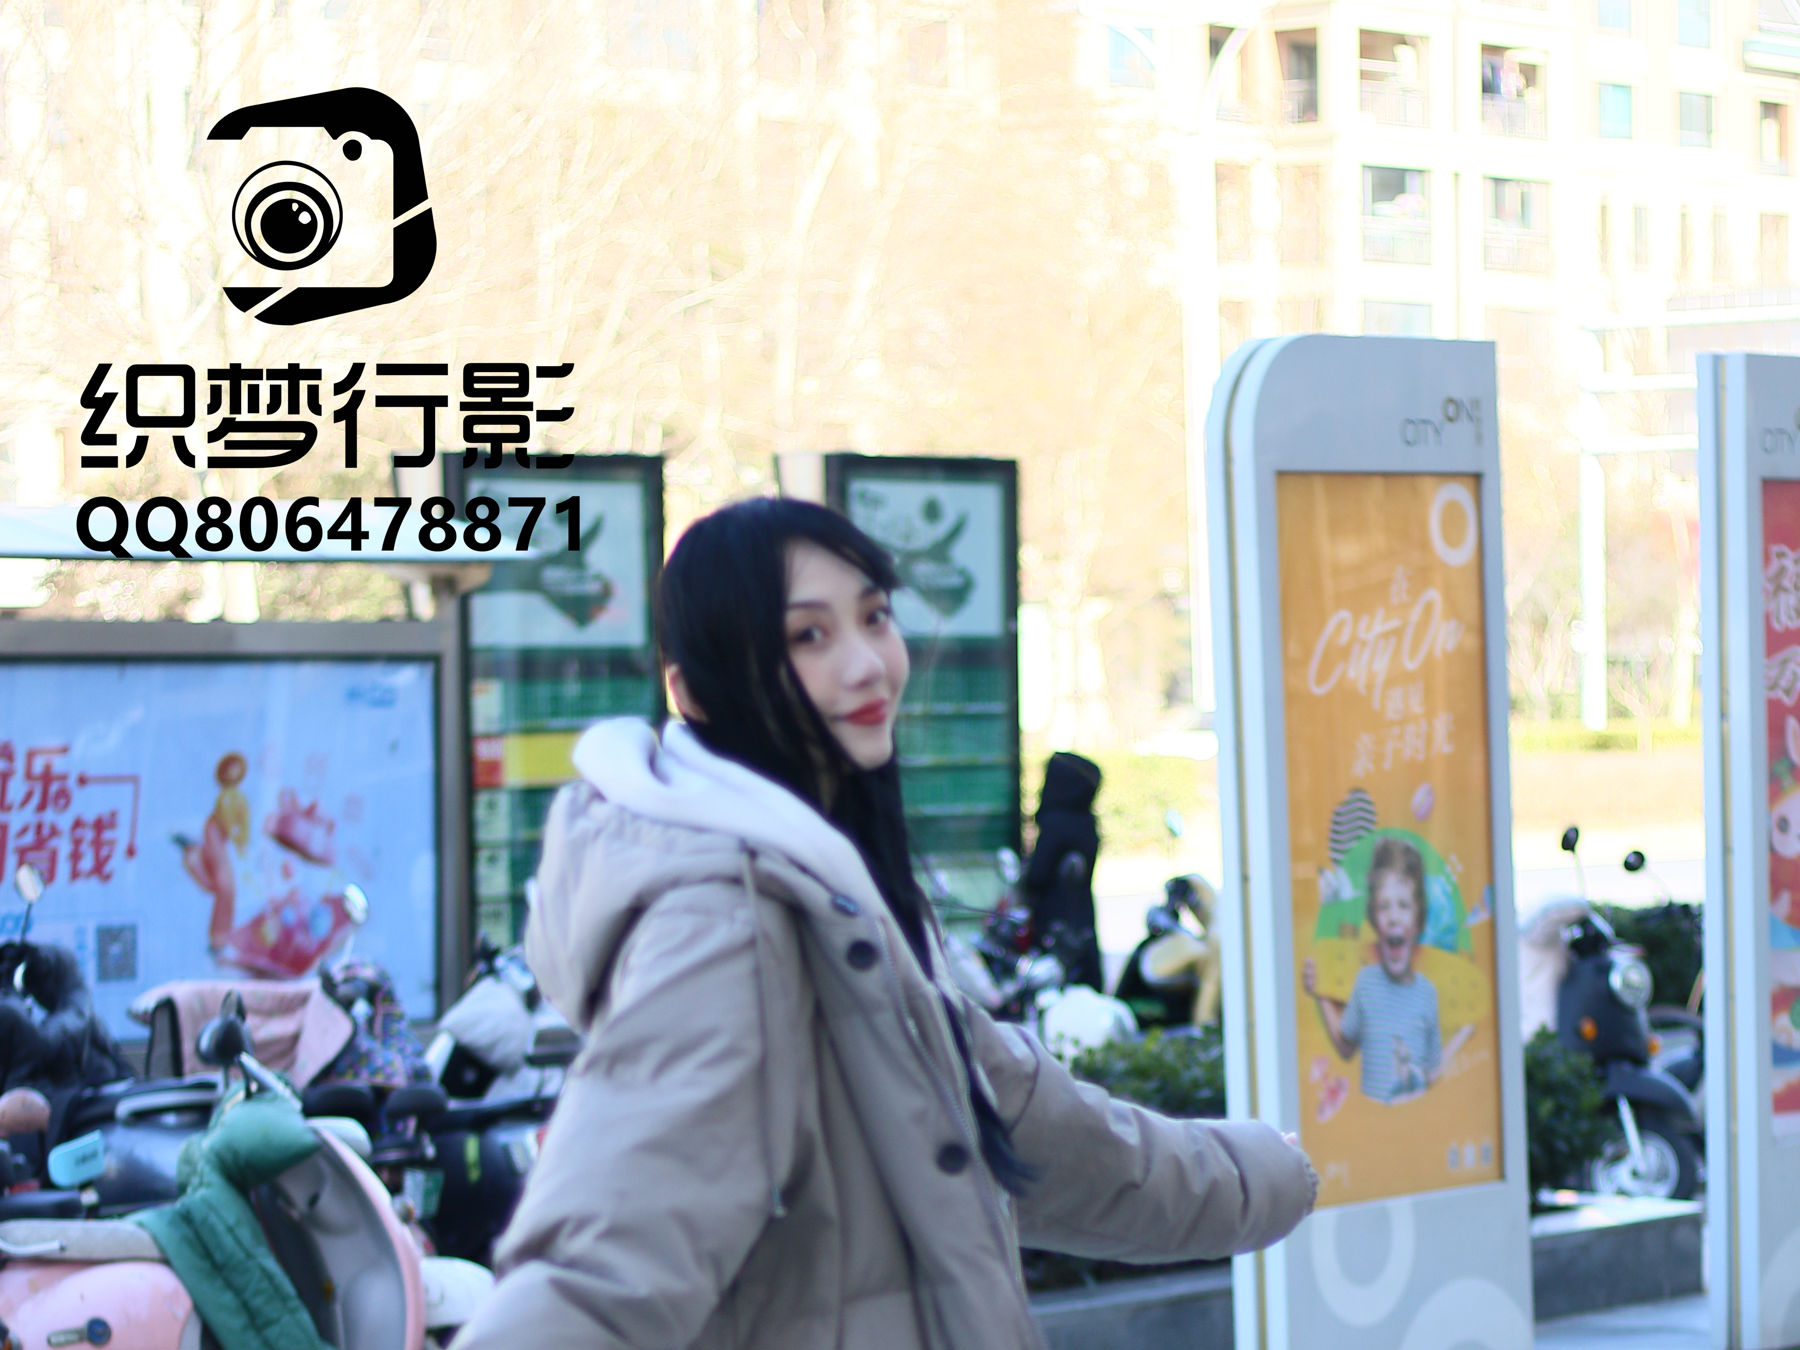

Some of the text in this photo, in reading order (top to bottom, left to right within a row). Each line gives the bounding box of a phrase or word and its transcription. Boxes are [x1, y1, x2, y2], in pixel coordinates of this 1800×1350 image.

[1307, 587, 1465, 712] City On
[1352, 712, 1455, 779] 亲子时光
[0, 810, 118, 884] 省钱
